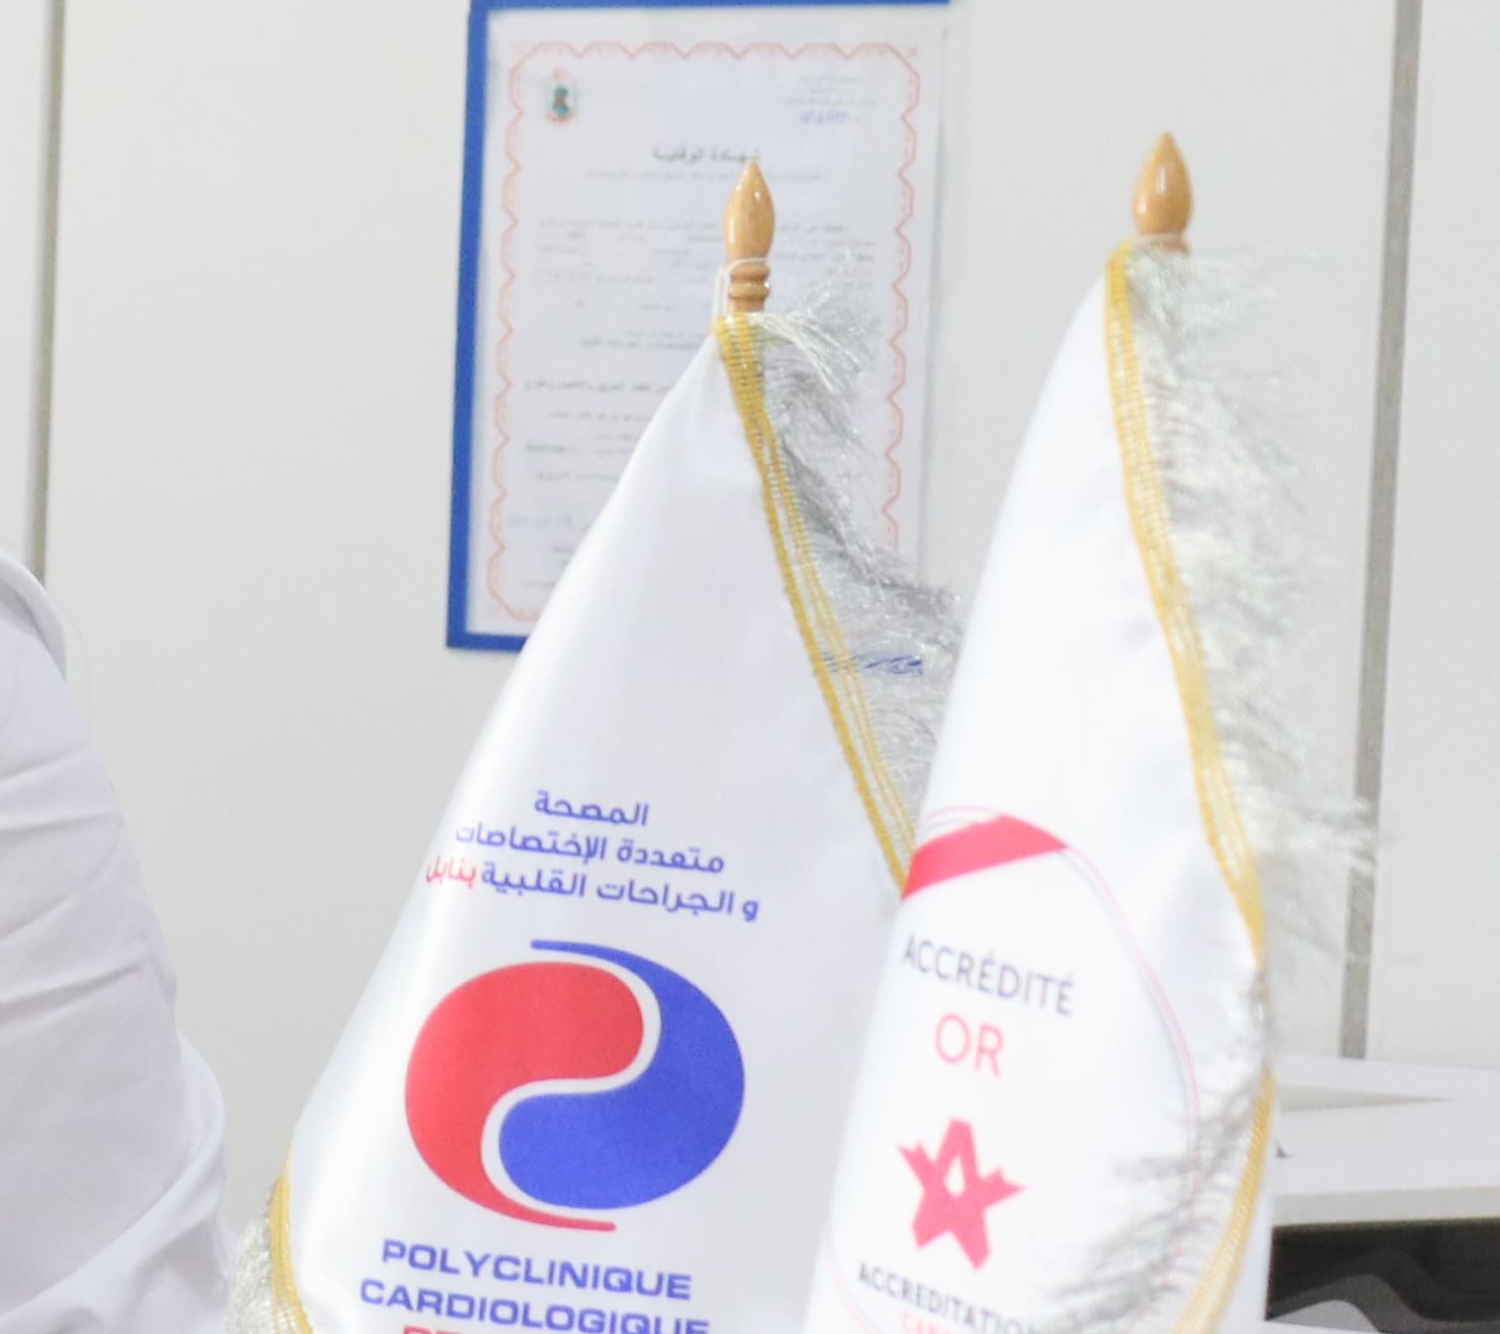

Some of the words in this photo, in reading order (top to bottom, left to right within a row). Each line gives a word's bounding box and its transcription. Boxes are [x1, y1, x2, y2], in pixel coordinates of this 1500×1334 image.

[534, 788, 649, 827] المصحة
[456, 820, 608, 866] الإختصاصات
[616, 837, 726, 875] متعددة
[424, 854, 478, 891] بنابل
[481, 860, 587, 898] القلبية
[596, 878, 736, 917] الجراحات
[741, 897, 760, 923] و
[903, 932, 1075, 1017] ACCRÉDITÉ
[935, 1013, 1005, 1080] OR
[381, 1237, 693, 1302] POLYCLINIQUE
